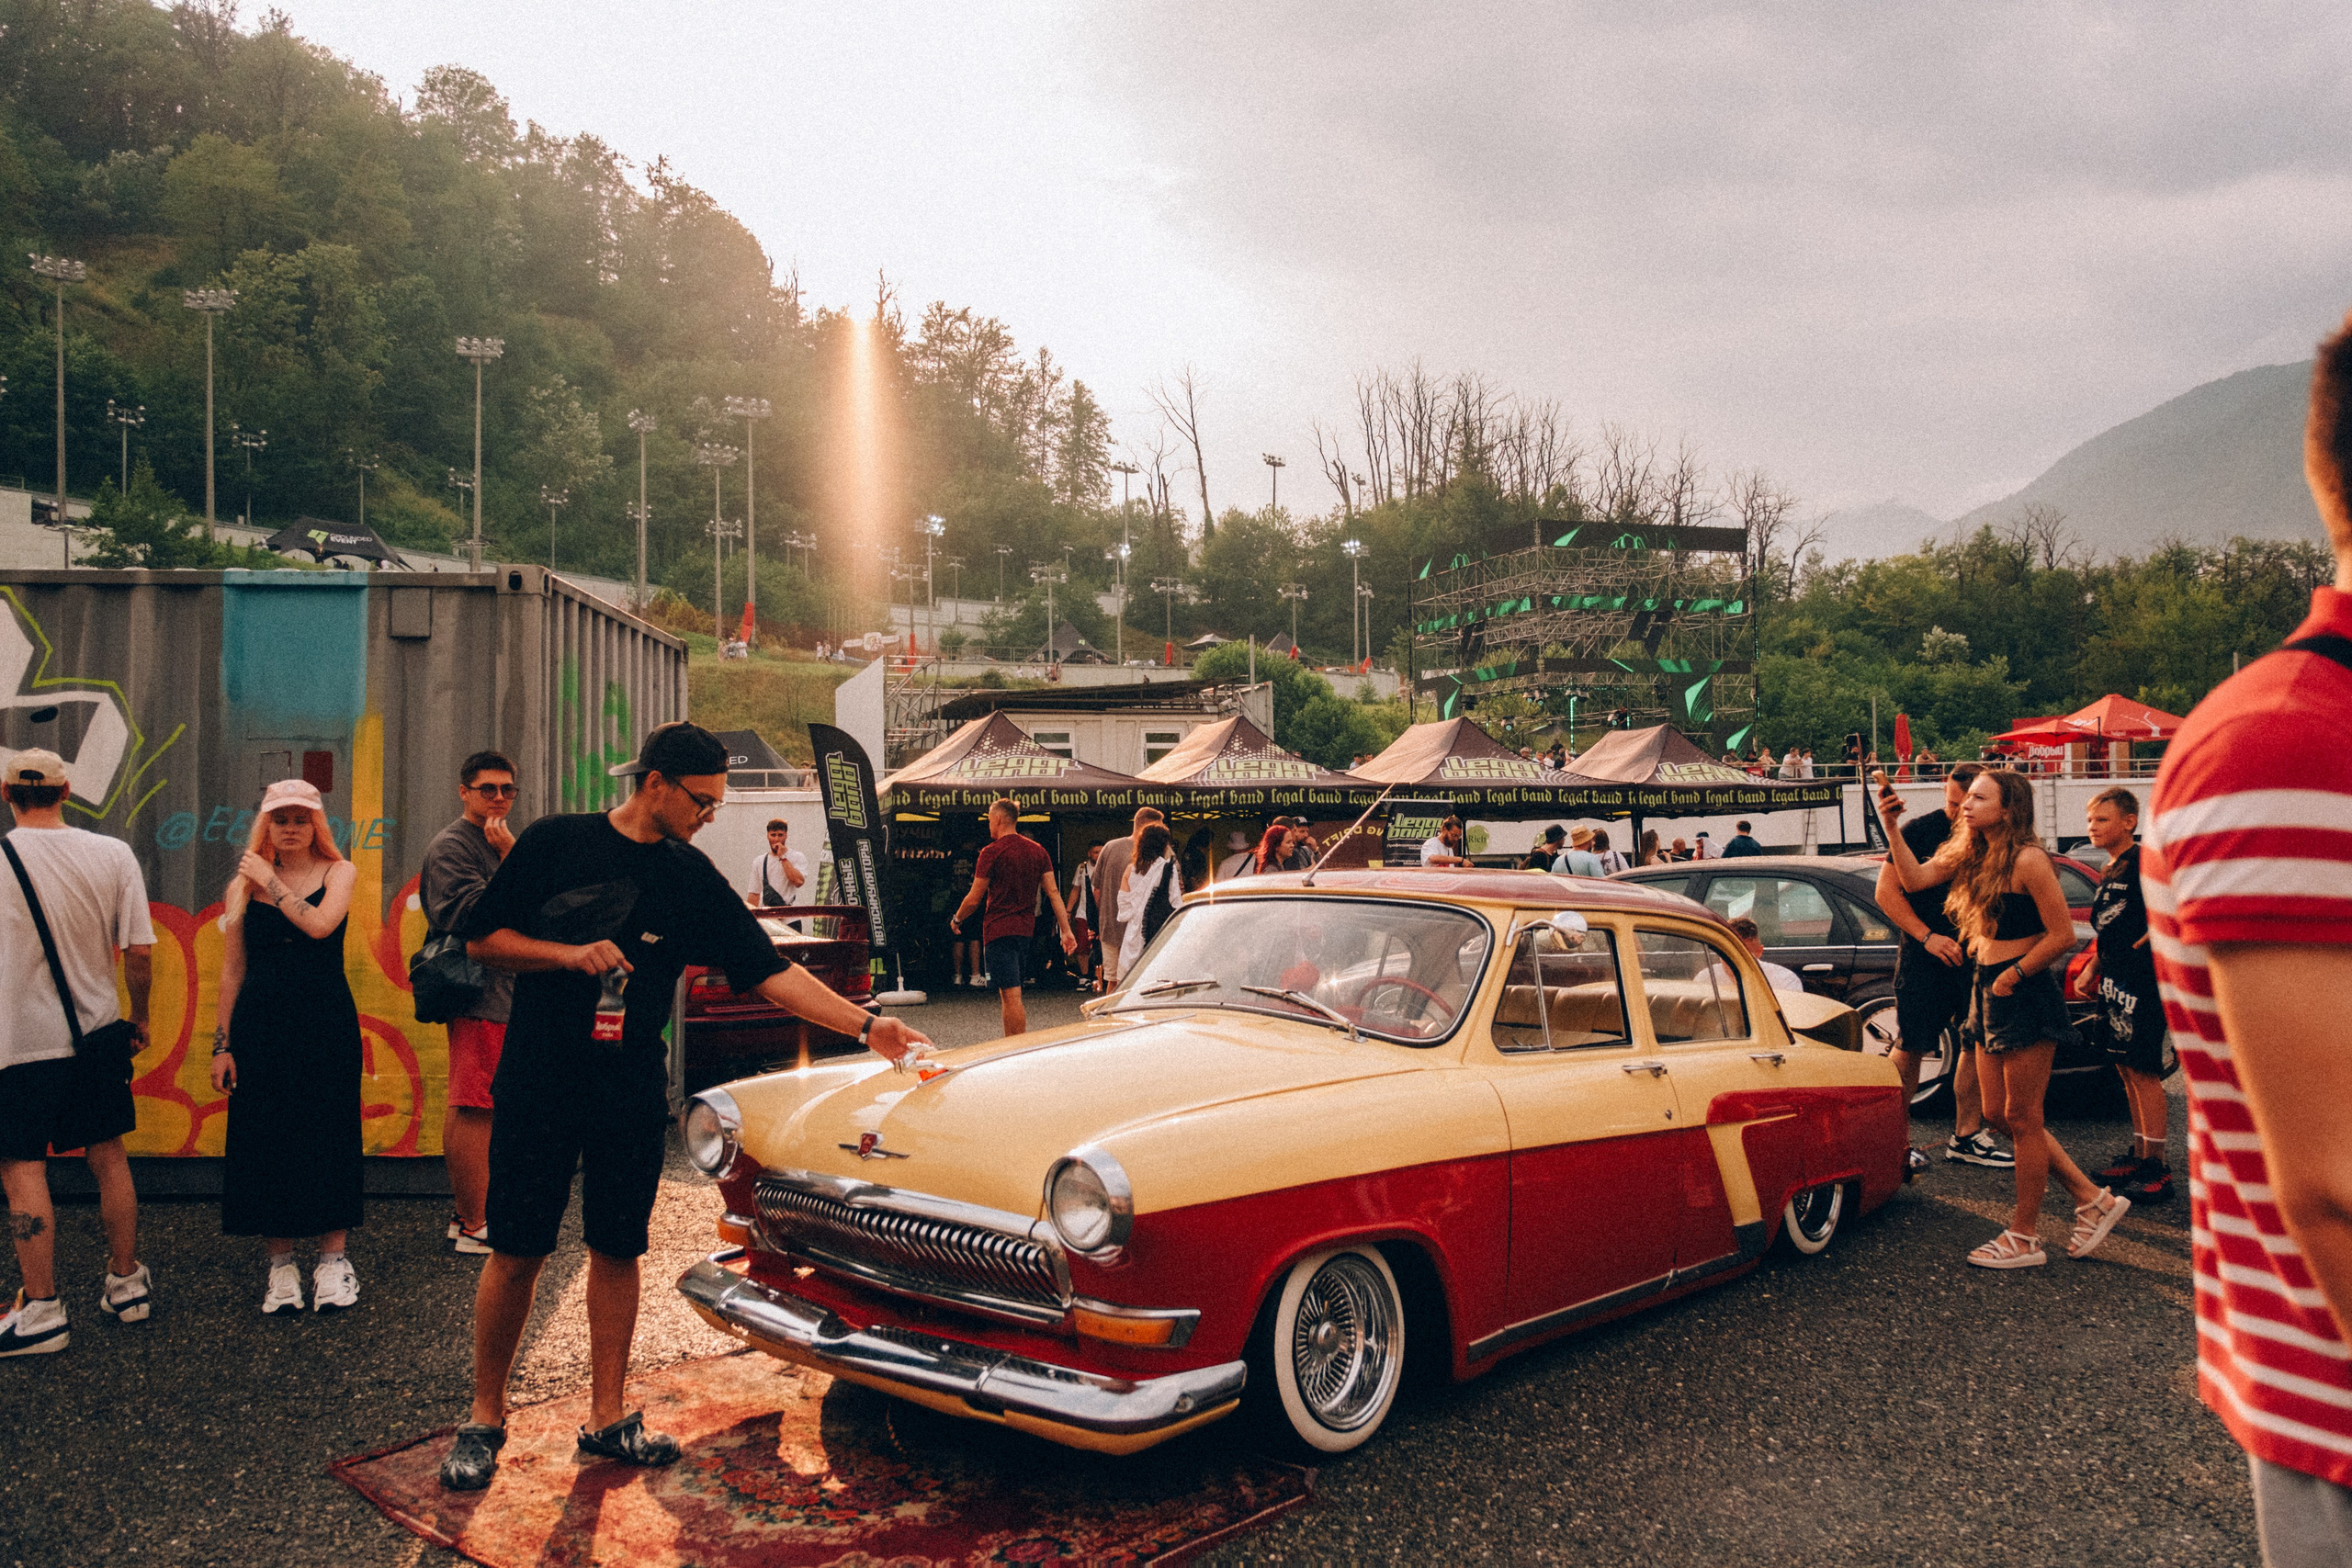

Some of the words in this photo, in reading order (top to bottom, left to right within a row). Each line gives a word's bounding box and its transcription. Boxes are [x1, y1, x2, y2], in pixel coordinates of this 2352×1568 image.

[919, 789, 957, 808] legal
[962, 789, 1001, 807] band
[1051, 789, 1089, 805] band
[1096, 789, 1133, 808] legal
[1191, 790, 1226, 808] legal
[1229, 789, 1264, 805] band
[1272, 788, 1305, 807] legal
[1308, 788, 1341, 804] band
[1349, 790, 1382, 807] legal
[1487, 788, 1518, 807] legal
[1521, 787, 1552, 803] band
[1558, 789, 1589, 807] legal
[1592, 790, 1623, 805] band
[1639, 791, 1668, 807] legal
[1671, 790, 1701, 805] band
[1706, 790, 1735, 807] legal
[1737, 790, 1766, 804] band
[1771, 788, 1800, 805] legal
[1803, 787, 1830, 801] band
[1468, 834, 1487, 843] Rich
[858, 839, 886, 946] АВТОСИМУЛЯТОРЫ
